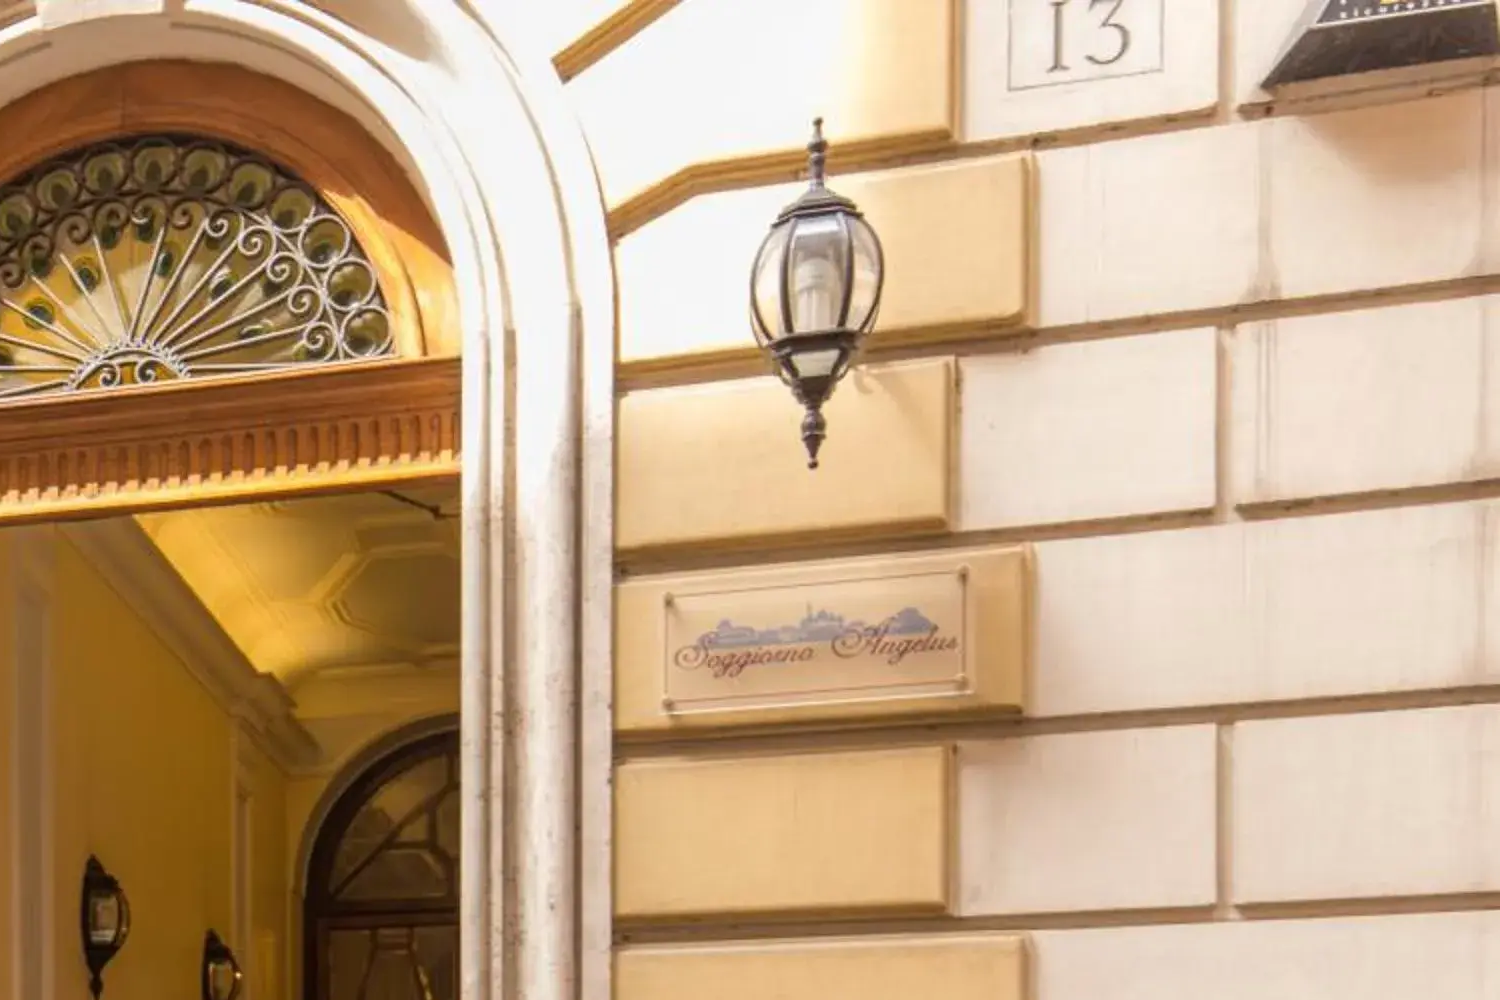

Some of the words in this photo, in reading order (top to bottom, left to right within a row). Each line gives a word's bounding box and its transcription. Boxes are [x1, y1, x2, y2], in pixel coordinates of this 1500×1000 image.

[1045, 0, 1131, 74] 13
[674, 631, 814, 679] Soggiorno
[831, 622, 959, 666] Angelus
